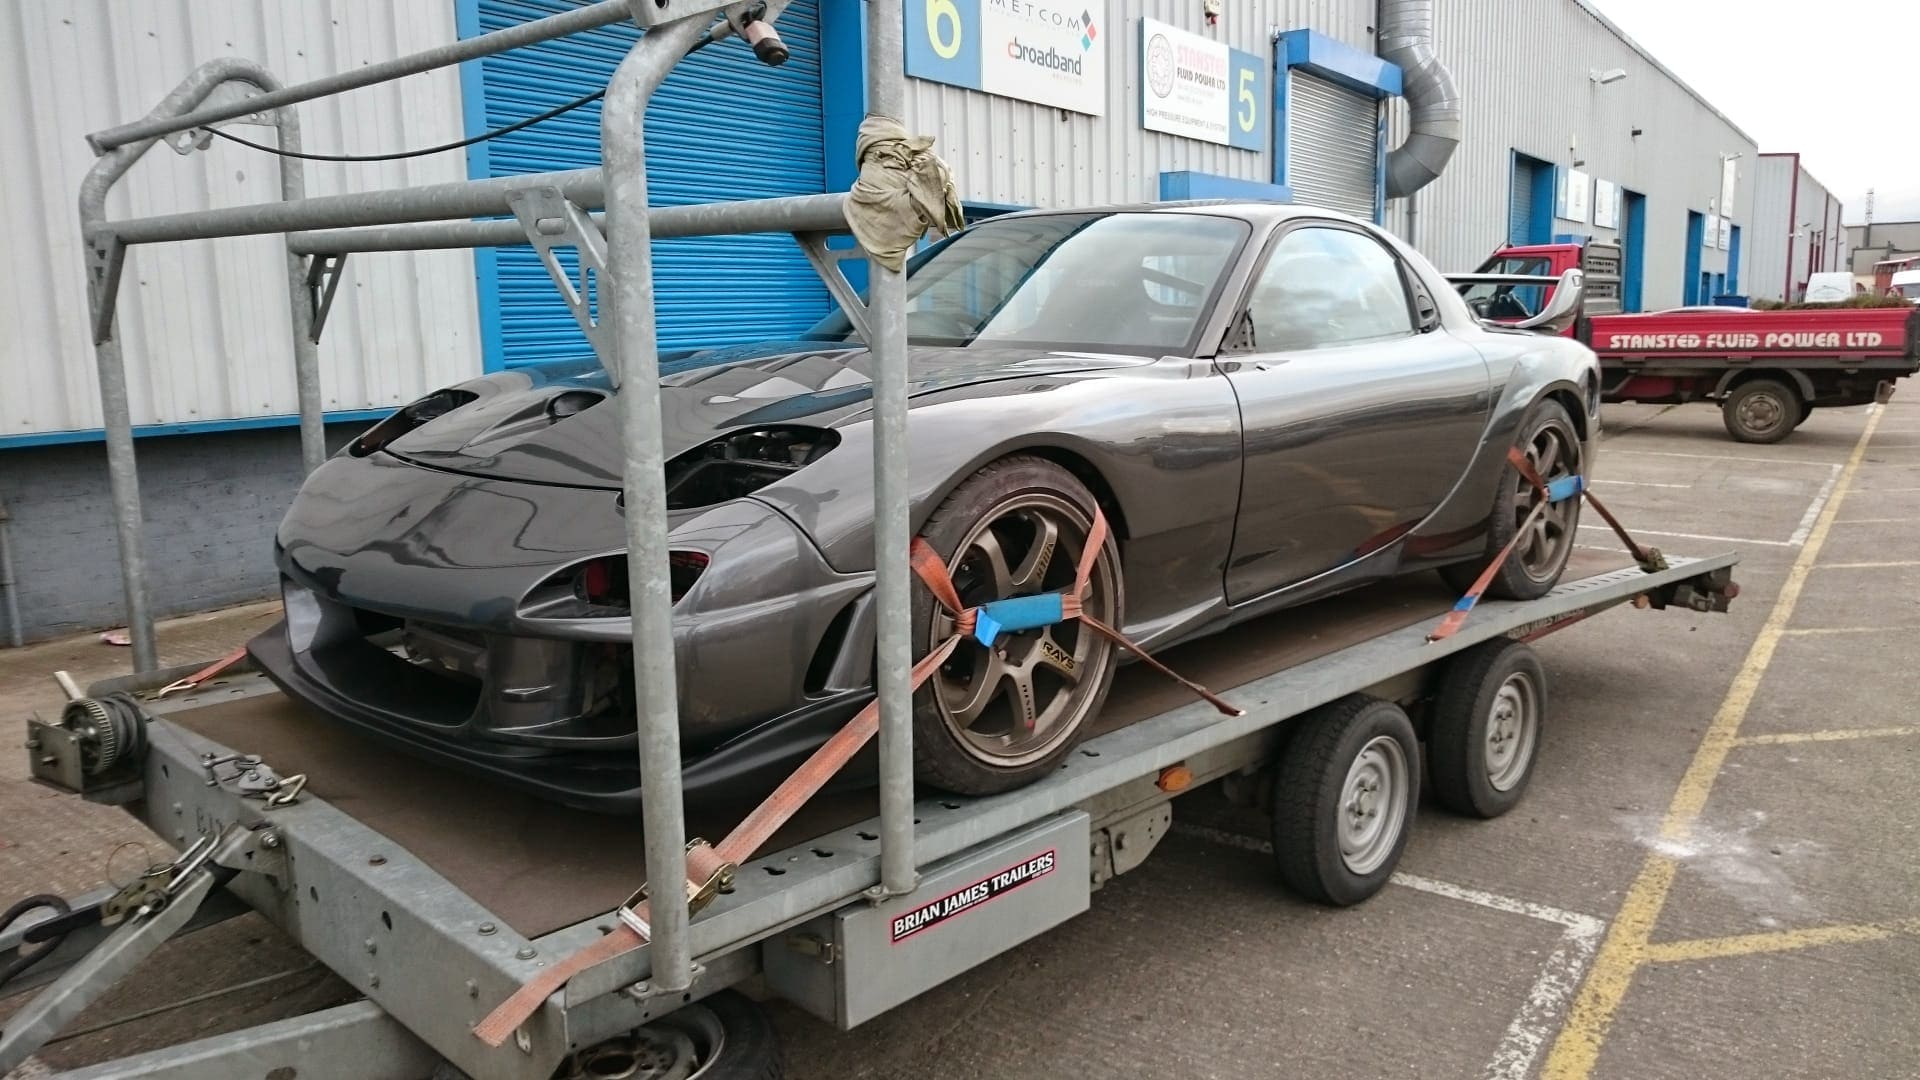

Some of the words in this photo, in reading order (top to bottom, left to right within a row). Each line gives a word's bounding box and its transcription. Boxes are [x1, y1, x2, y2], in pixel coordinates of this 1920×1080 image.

[926, 0, 962, 59] 6
[1008, 36, 1082, 76] broadband
[1177, 67, 1194, 84] FLUID
[1194, 72, 1215, 89] POWER
[1216, 78, 1226, 91] LTD
[1238, 68, 1256, 133] 5
[1610, 334, 1700, 349] STANSTED
[1706, 334, 1760, 349] FLUID
[1765, 332, 1840, 348] POWER
[1846, 332, 1882, 348] LTD
[1042, 641, 1076, 670] RAYS
[894, 903, 940, 936] BRIAN
[942, 881, 989, 917] JAMES
[991, 852, 1054, 892] TRAILERS
